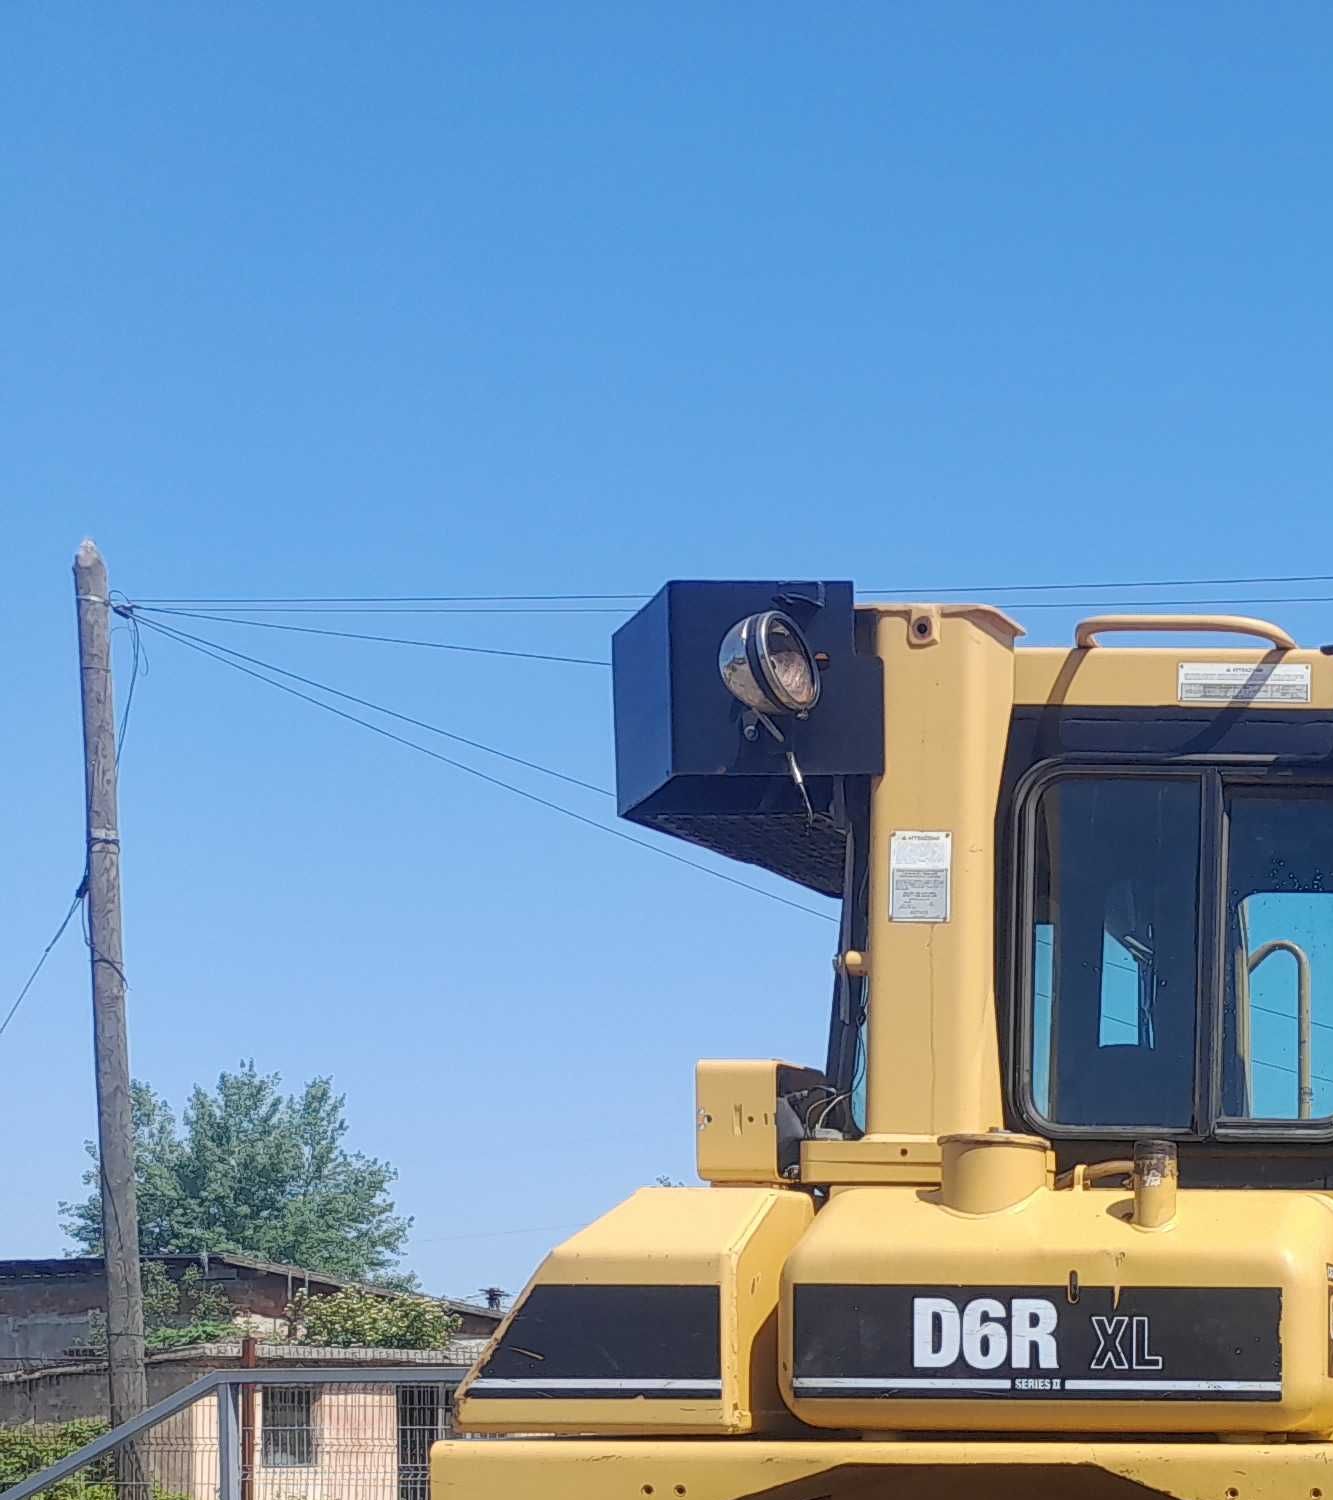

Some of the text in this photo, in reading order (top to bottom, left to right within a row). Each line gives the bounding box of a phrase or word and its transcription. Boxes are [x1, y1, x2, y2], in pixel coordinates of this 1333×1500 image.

[913, 1298, 1162, 1370] D6R XL
[1015, 1378, 1050, 1390] SERIES
